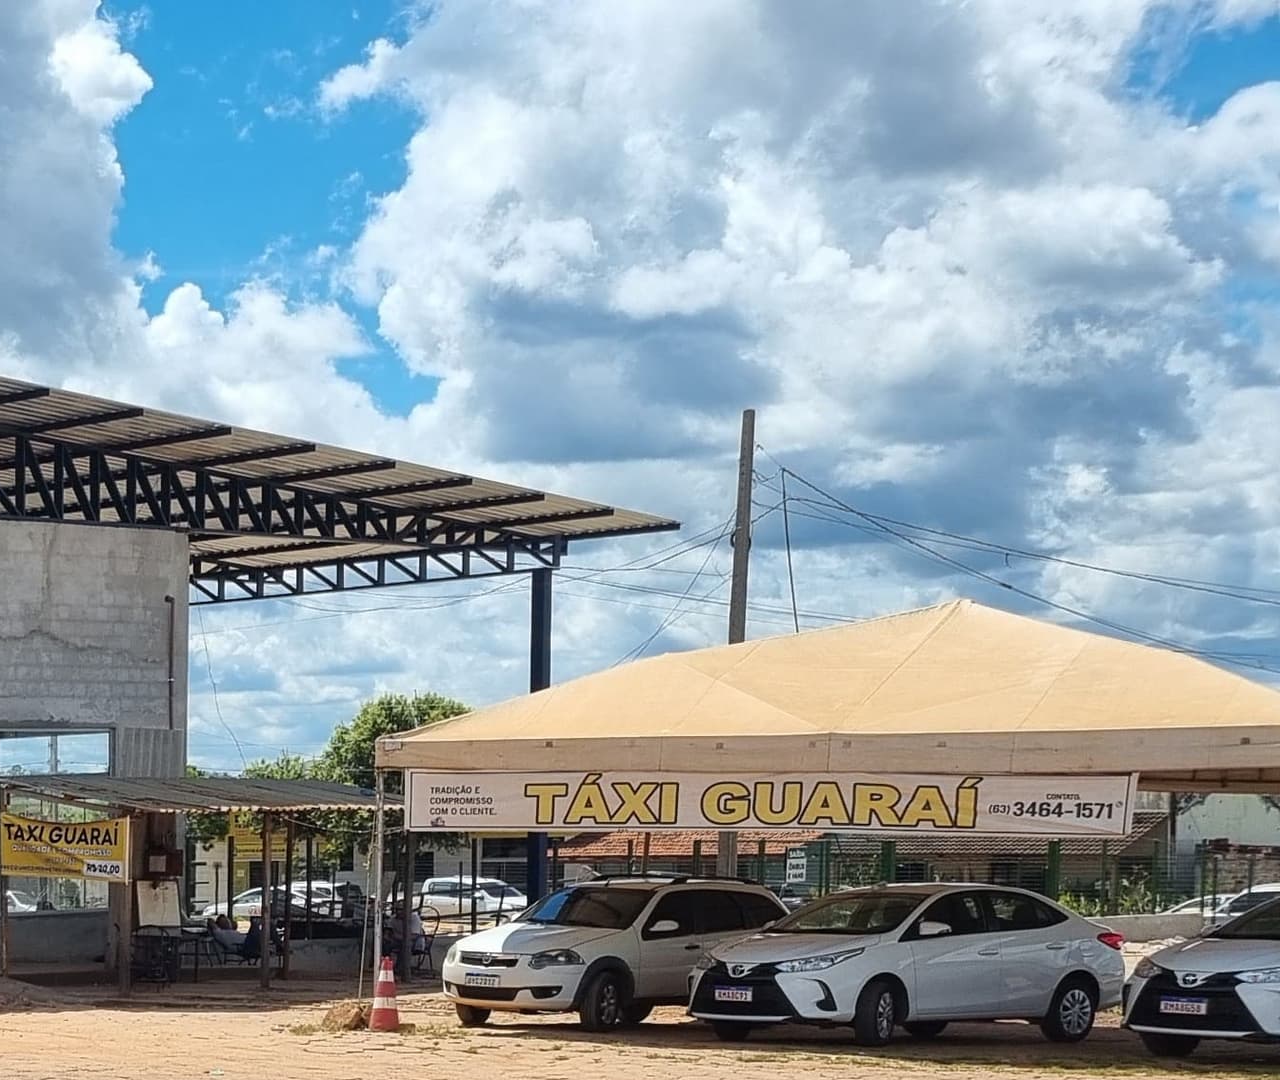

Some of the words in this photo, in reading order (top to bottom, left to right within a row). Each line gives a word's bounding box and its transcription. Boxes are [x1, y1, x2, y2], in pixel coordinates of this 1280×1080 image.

[430, 784, 472, 795] TRADIÇÃO
[474, 786, 481, 794] E
[429, 796, 493, 805] COMPROMISSO
[524, 773, 680, 825] TÁXI
[700, 777, 984, 828] GUARAÍ
[429, 807, 449, 816] COM
[450, 807, 458, 816] O
[988, 803, 1011, 815] (63)
[1012, 801, 1114, 819] 3464-1571
[3, 823, 45, 842] TAXI
[48, 822, 119, 846] GUARAÍ
